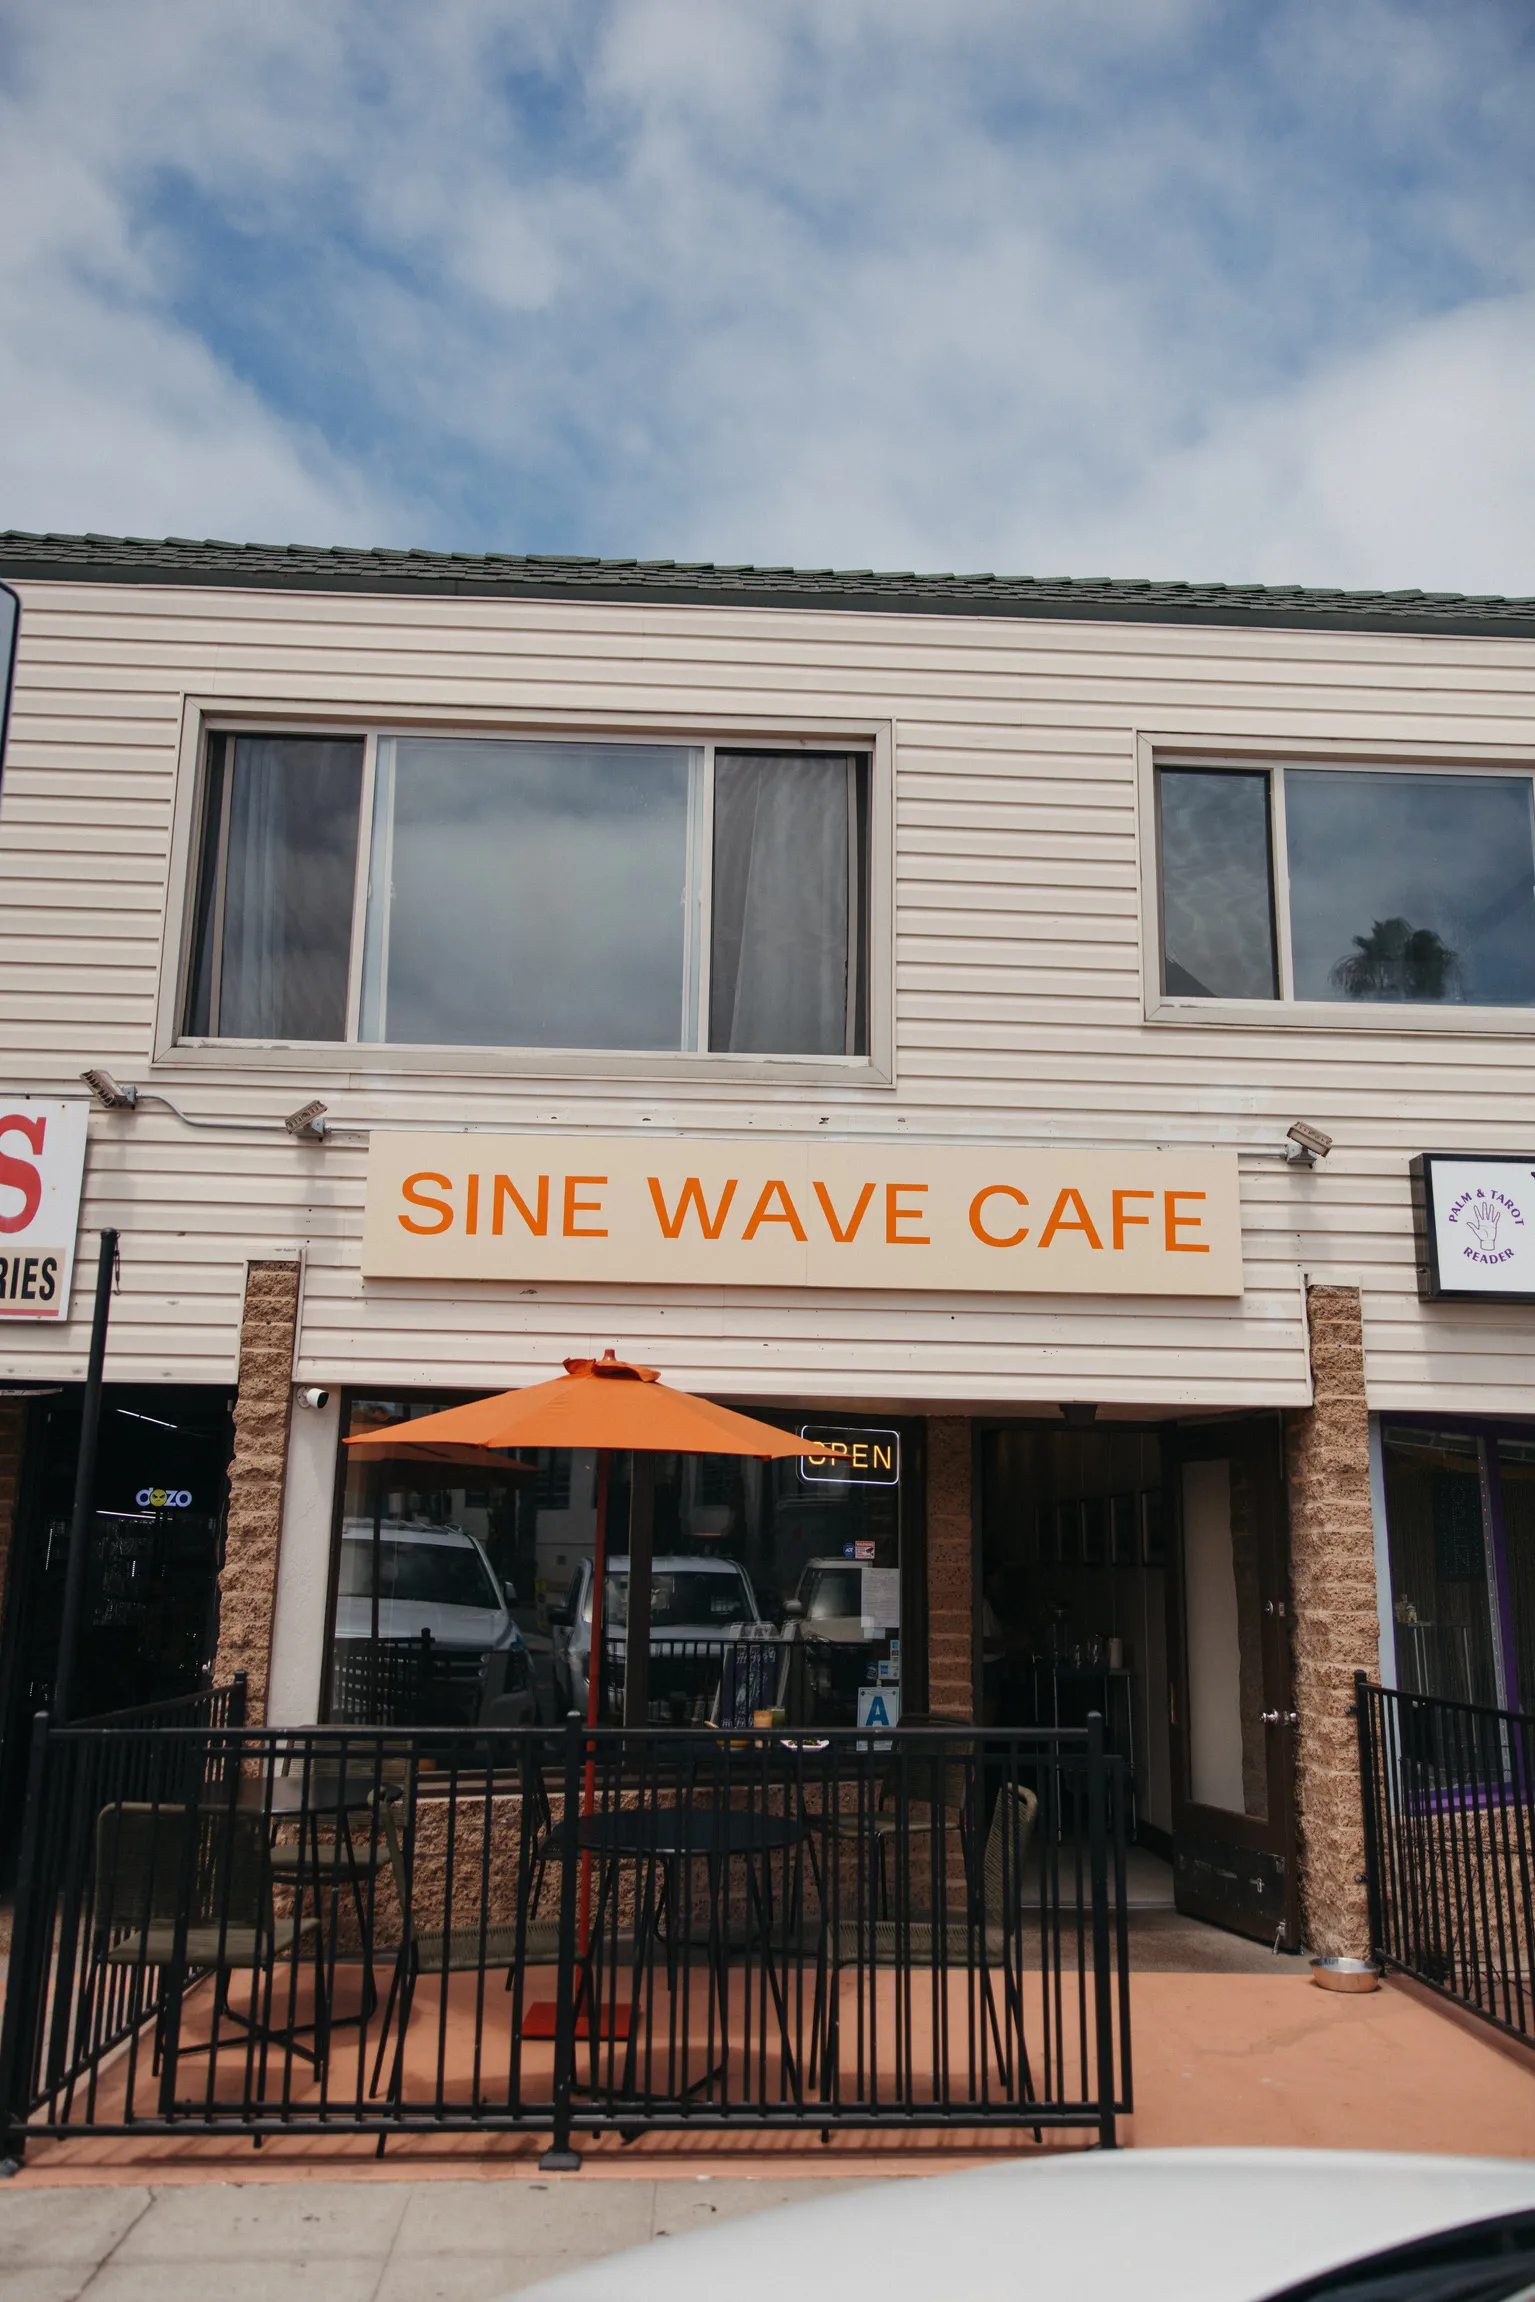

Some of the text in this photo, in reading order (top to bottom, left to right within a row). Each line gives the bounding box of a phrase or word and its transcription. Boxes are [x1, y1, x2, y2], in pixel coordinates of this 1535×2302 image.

[397, 1171, 1211, 1253] SINE WAVE CAFE
[1449, 1188, 1525, 1226] PALM & TAROT
[1463, 1246, 1515, 1265] READER
[808, 1441, 891, 1470] OPEN
[865, 1695, 890, 1727] A
